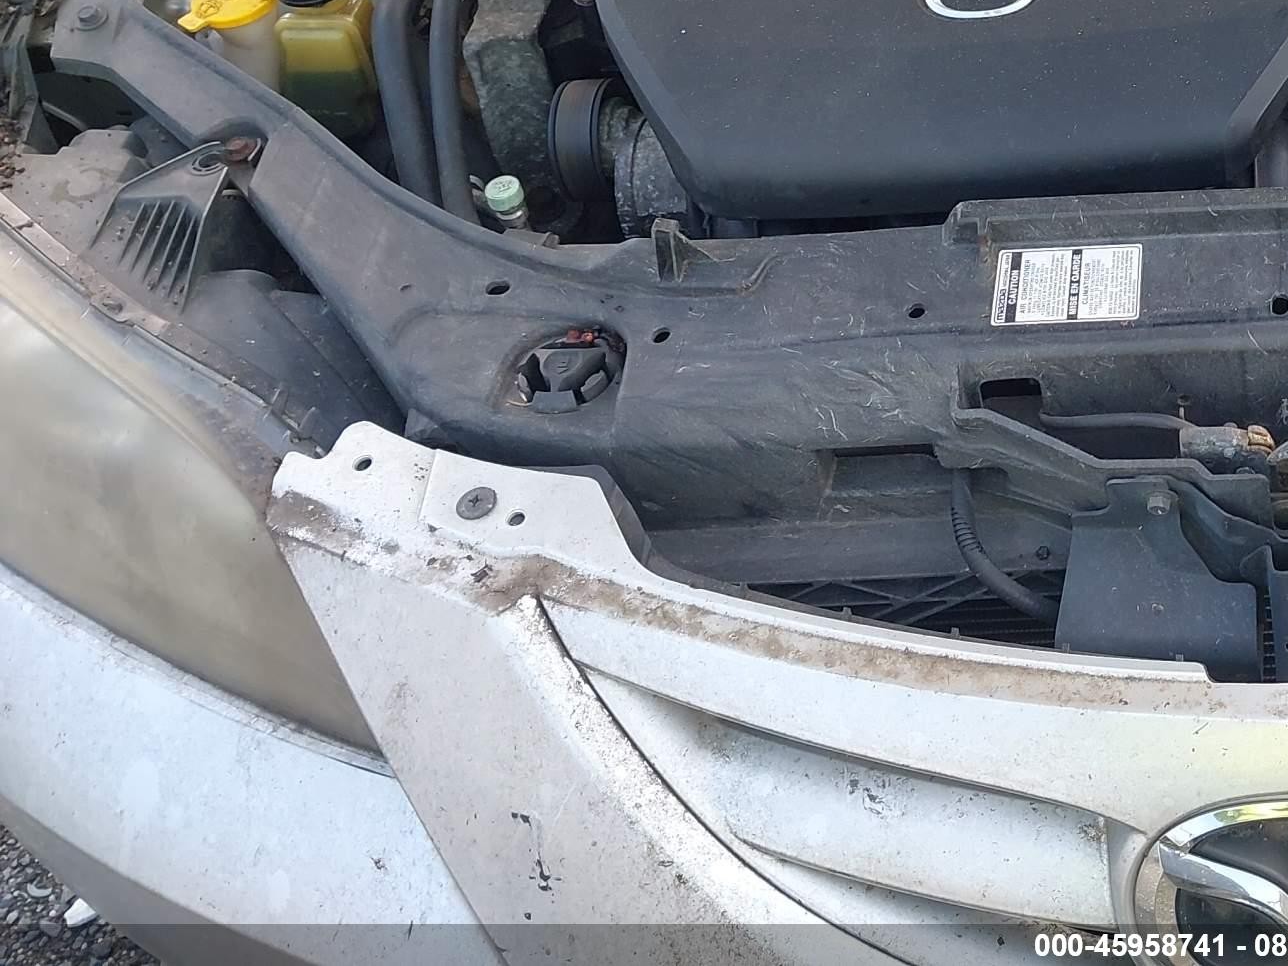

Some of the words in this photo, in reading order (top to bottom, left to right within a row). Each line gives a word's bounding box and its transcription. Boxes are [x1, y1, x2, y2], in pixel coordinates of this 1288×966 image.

[1021, 259, 1031, 300] CONDITIONER
[1071, 254, 1081, 281] GARDE
[1008, 269, 1019, 305] CAUTION
[1070, 282, 1079, 294] EN
[1081, 262, 1091, 305] CLIMATISEUR
[1068, 295, 1078, 315] MISE
